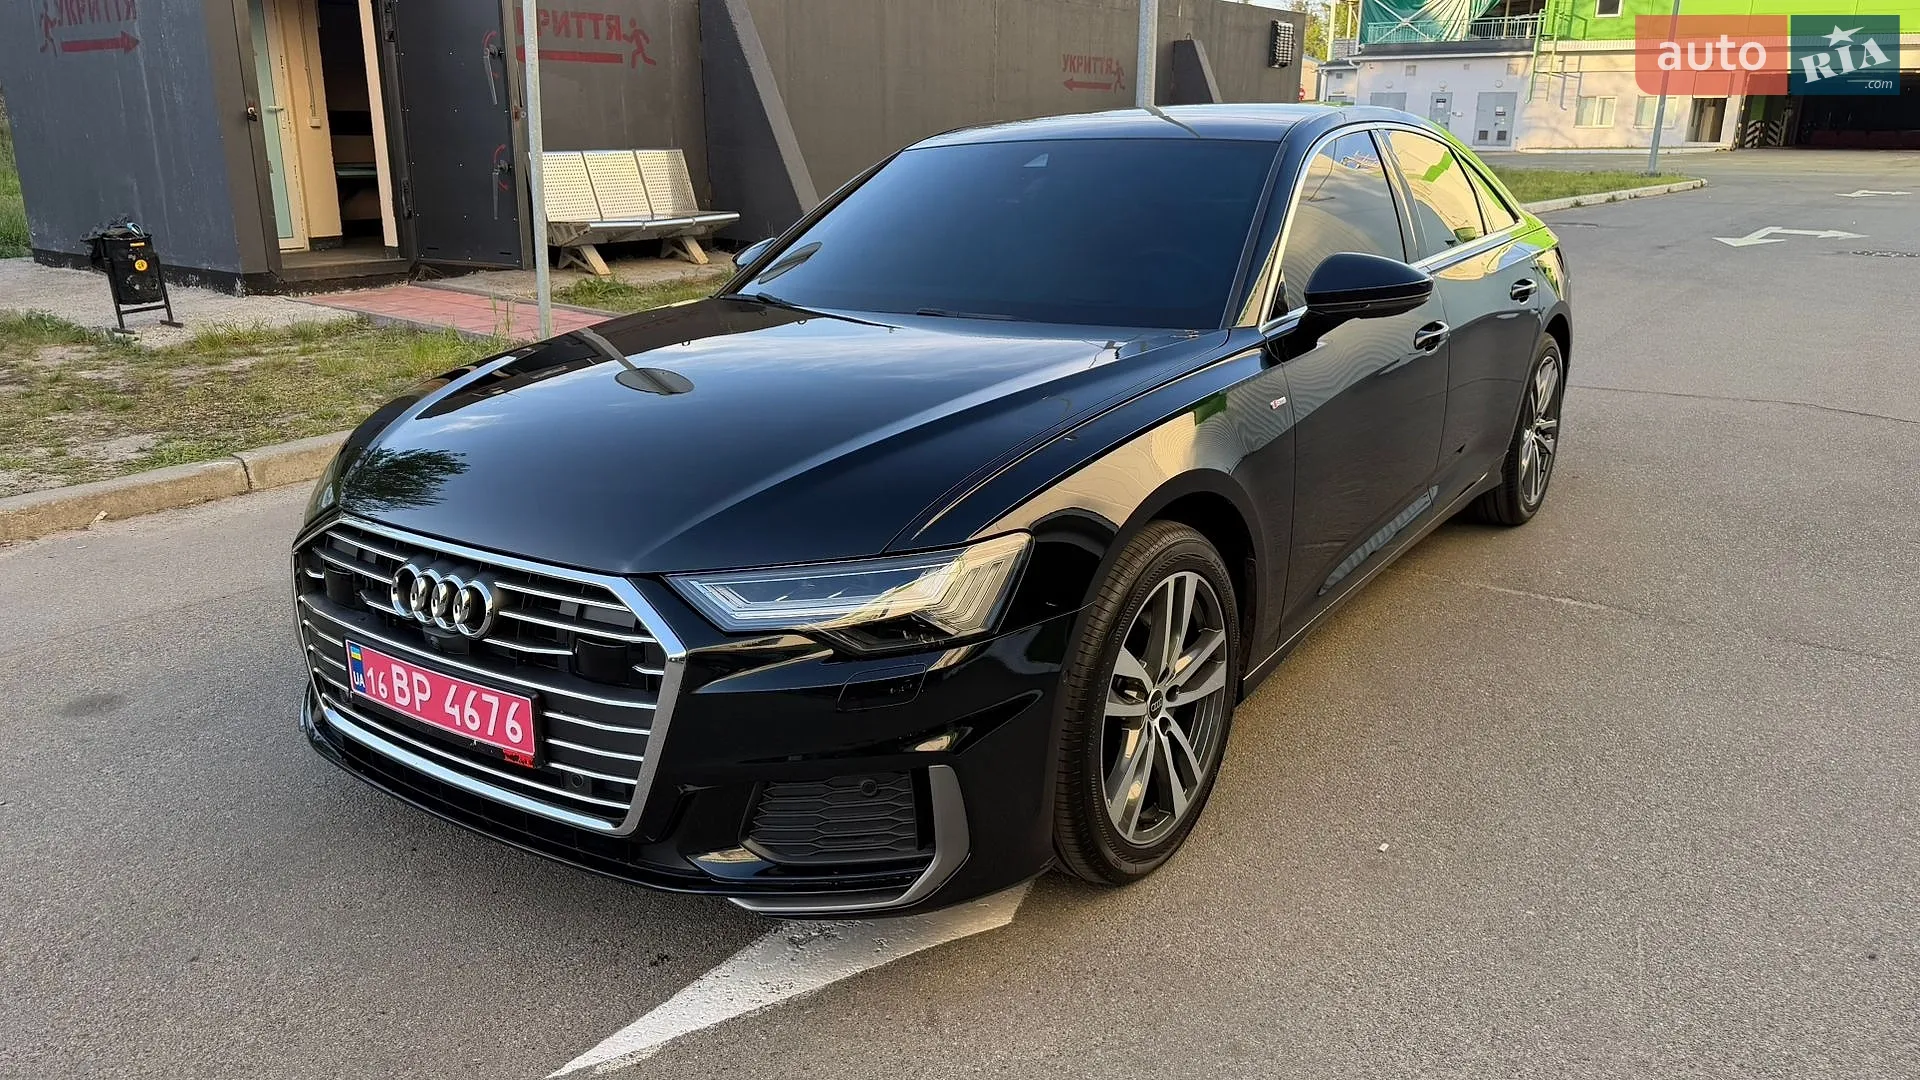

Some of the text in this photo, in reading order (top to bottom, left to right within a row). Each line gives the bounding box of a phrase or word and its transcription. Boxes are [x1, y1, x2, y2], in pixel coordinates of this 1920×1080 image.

[1062, 54, 1113, 75] УКРИТТЯ
[353, 671, 366, 688] UA
[444, 684, 523, 744] 4676
